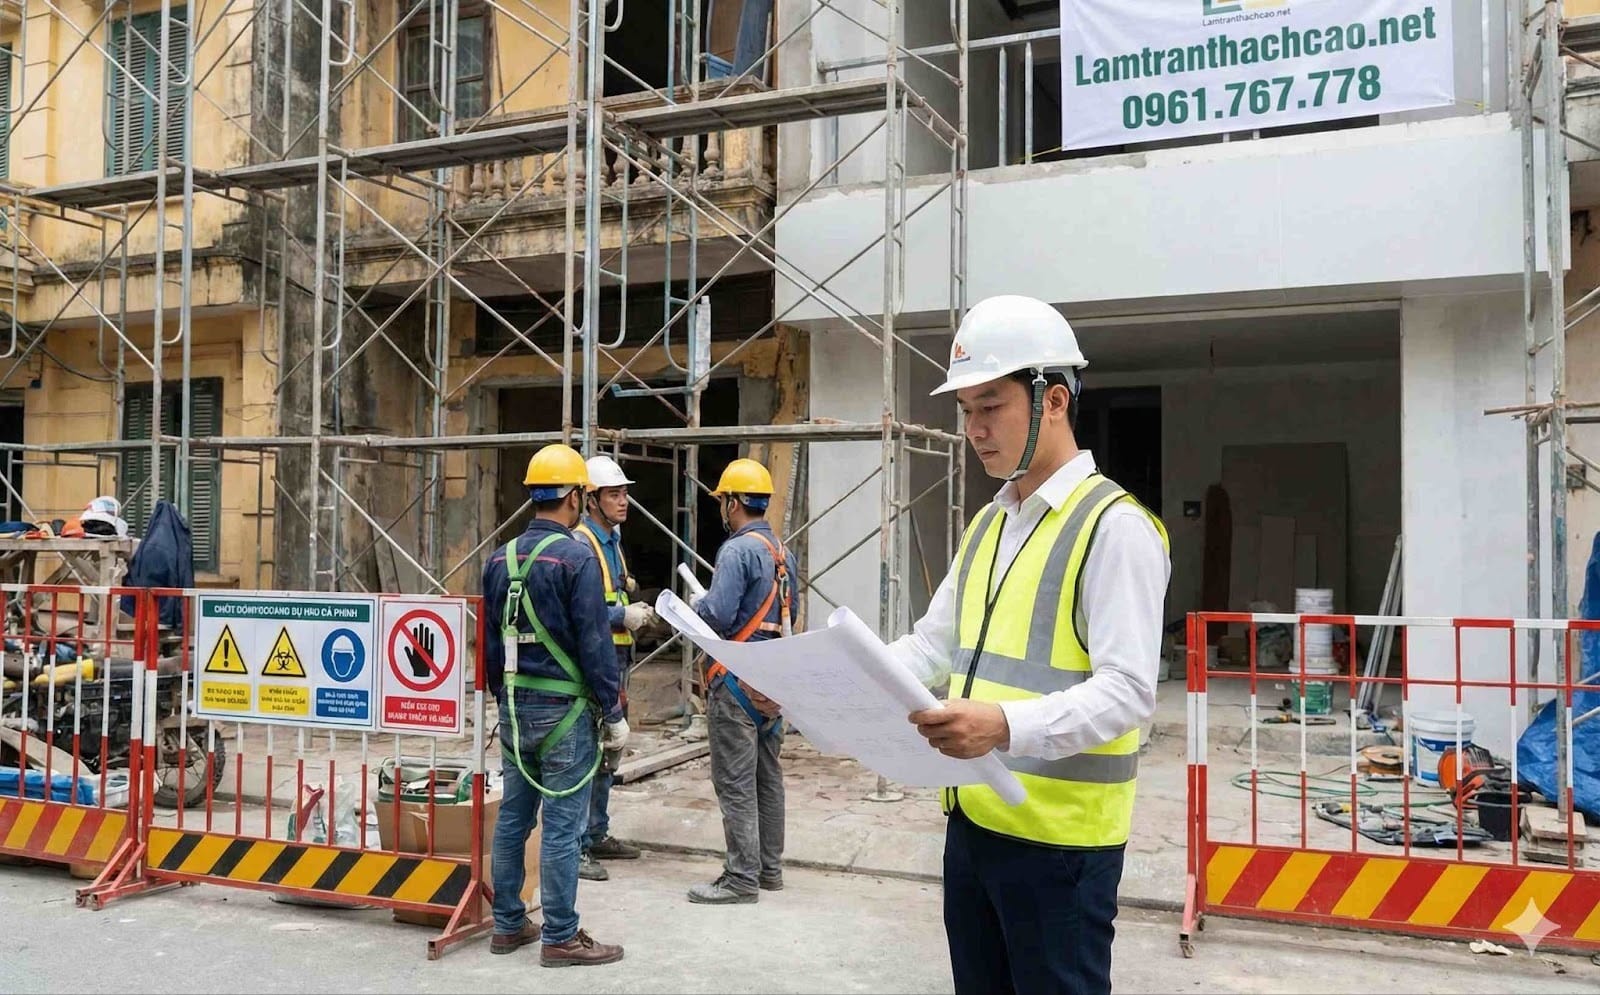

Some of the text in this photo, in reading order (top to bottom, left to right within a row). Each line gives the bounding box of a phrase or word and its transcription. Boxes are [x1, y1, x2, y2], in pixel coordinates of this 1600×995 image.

[1075, 7, 1436, 86] Lamtranthachcao.net
[1202, 8, 1291, 27] Lamtranthachcao.net
[1122, 65, 1381, 129] 0961.767.778
